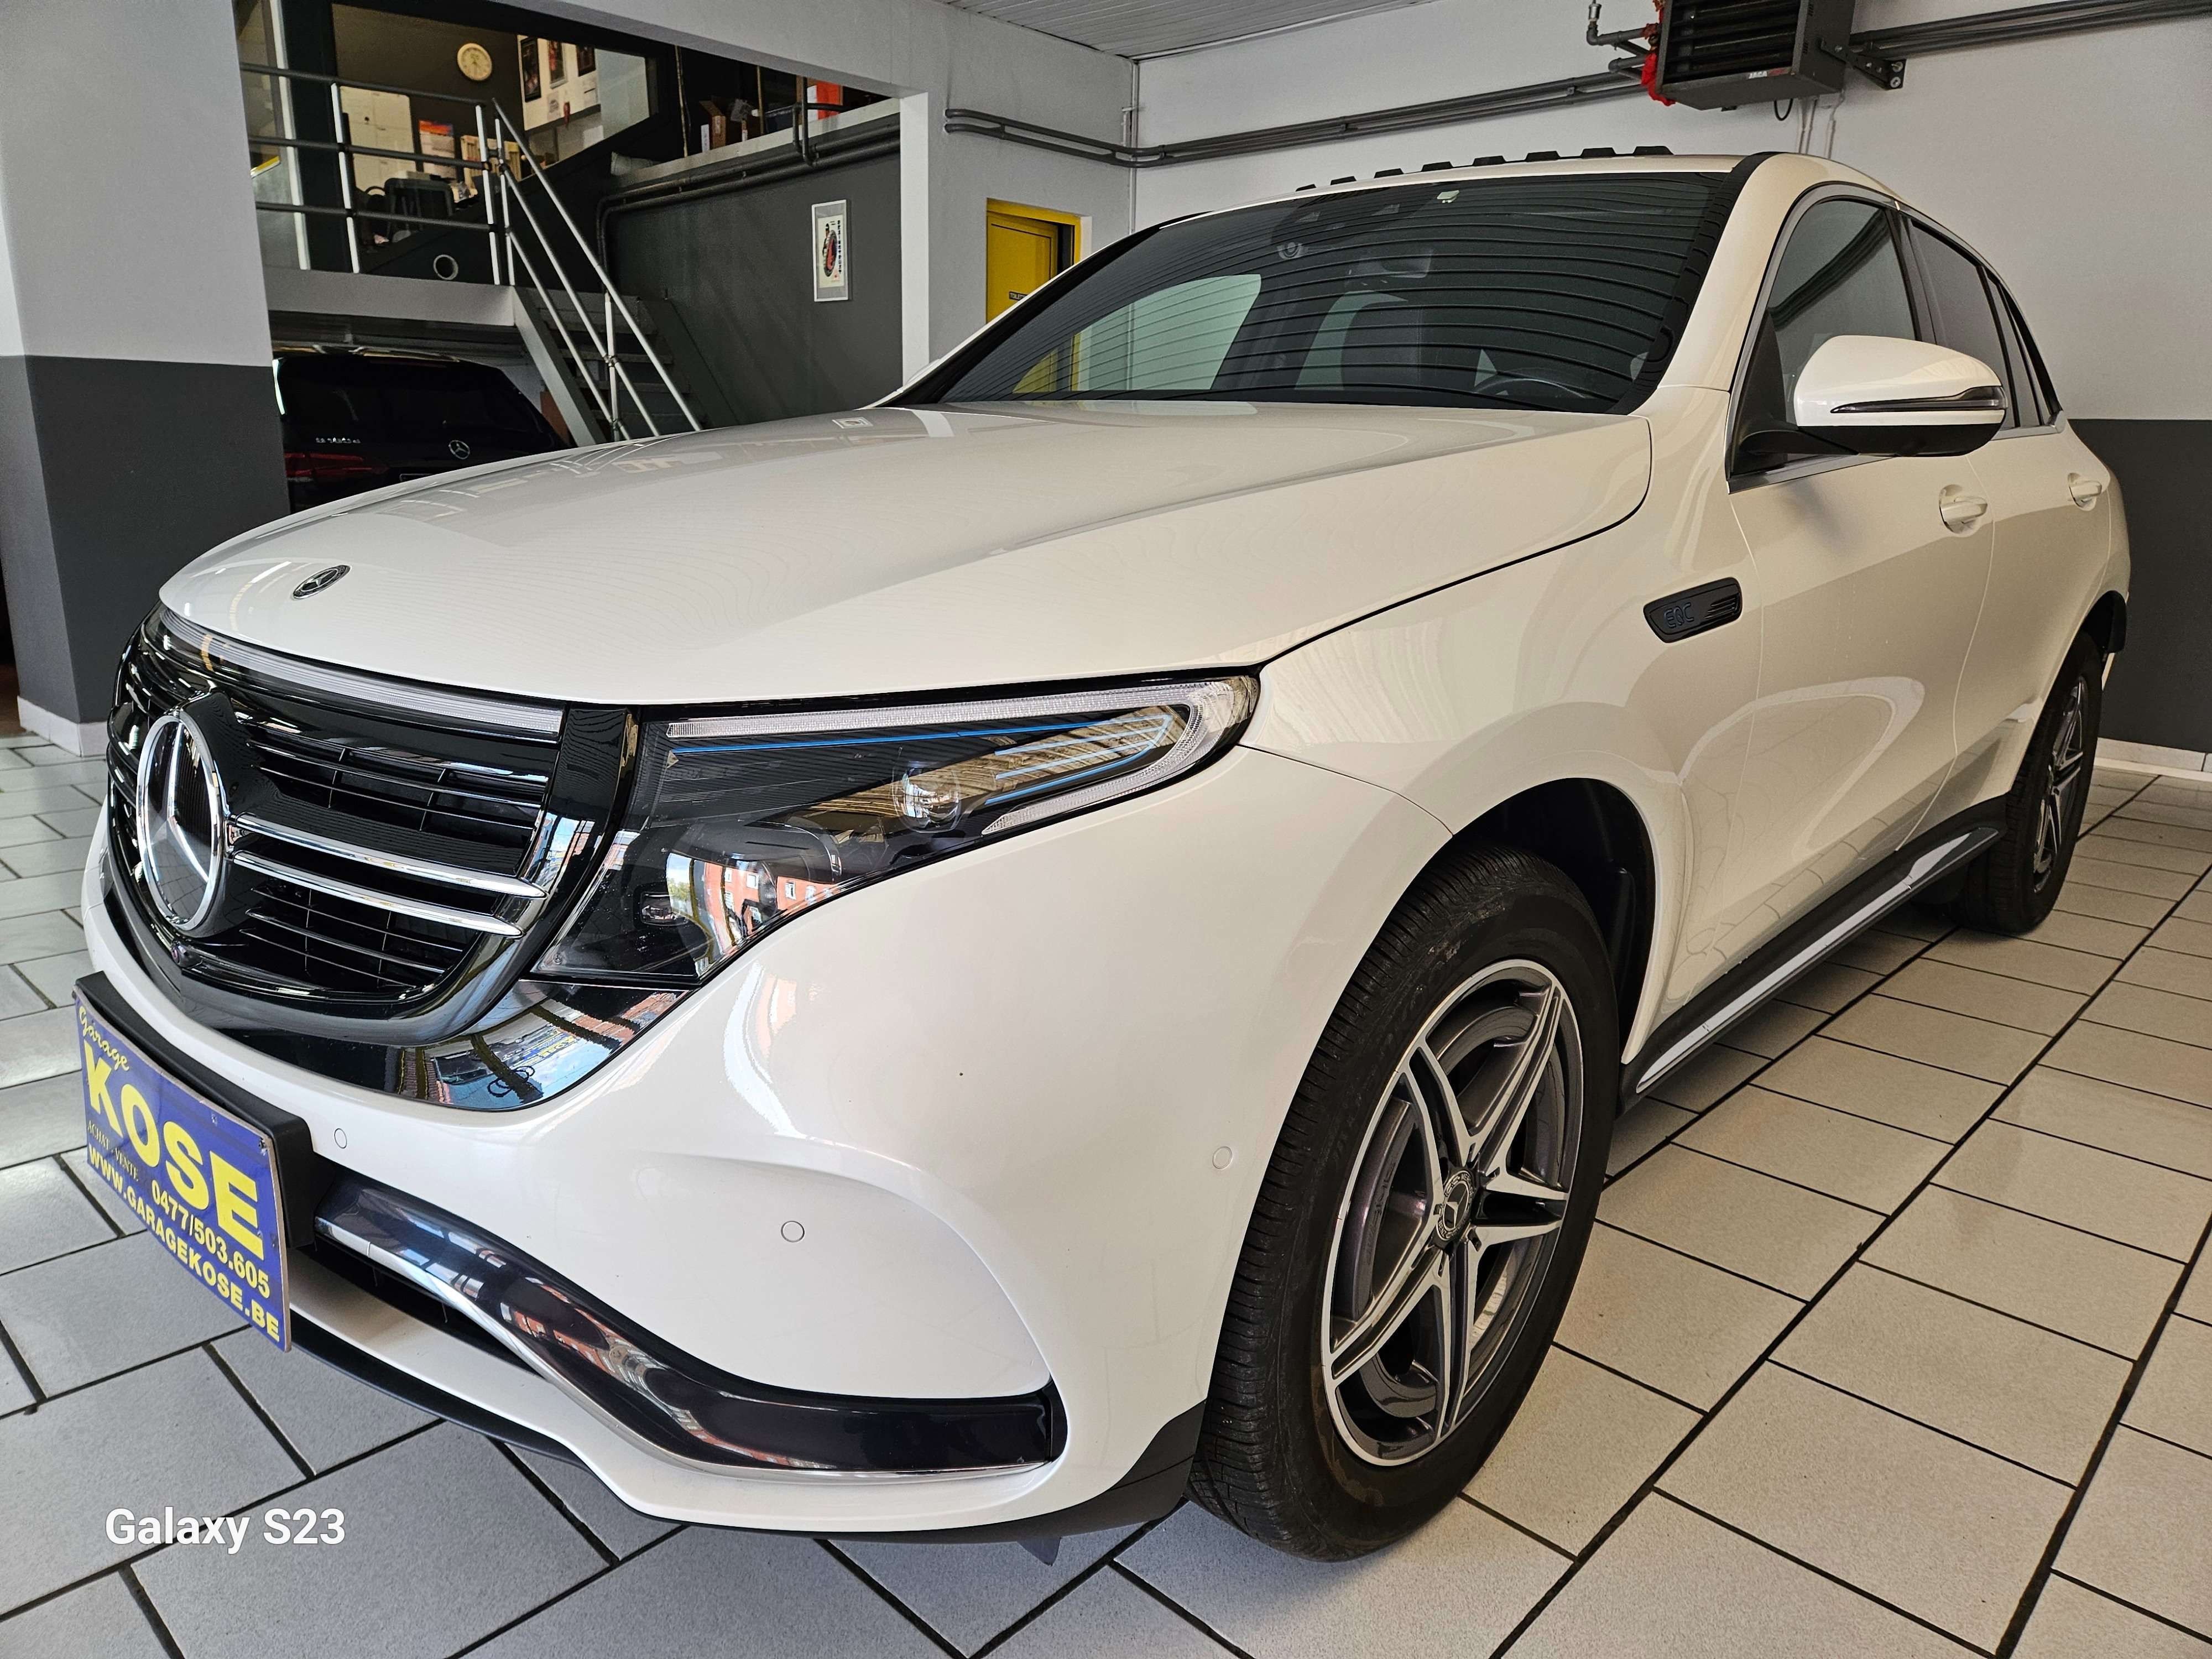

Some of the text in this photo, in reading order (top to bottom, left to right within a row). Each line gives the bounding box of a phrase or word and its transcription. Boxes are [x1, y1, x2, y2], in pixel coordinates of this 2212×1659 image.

[1664, 602, 1694, 628] EQC
[79, 1006, 129, 1071] Garage
[84, 1039, 264, 1261] KOSE
[88, 1120, 110, 1150] ACHAT
[115, 1147, 138, 1181] VENTE
[88, 1142, 280, 1342] WWW.GARAGEKOSE.BE
[152, 1180, 270, 1298] 0477/503.605
